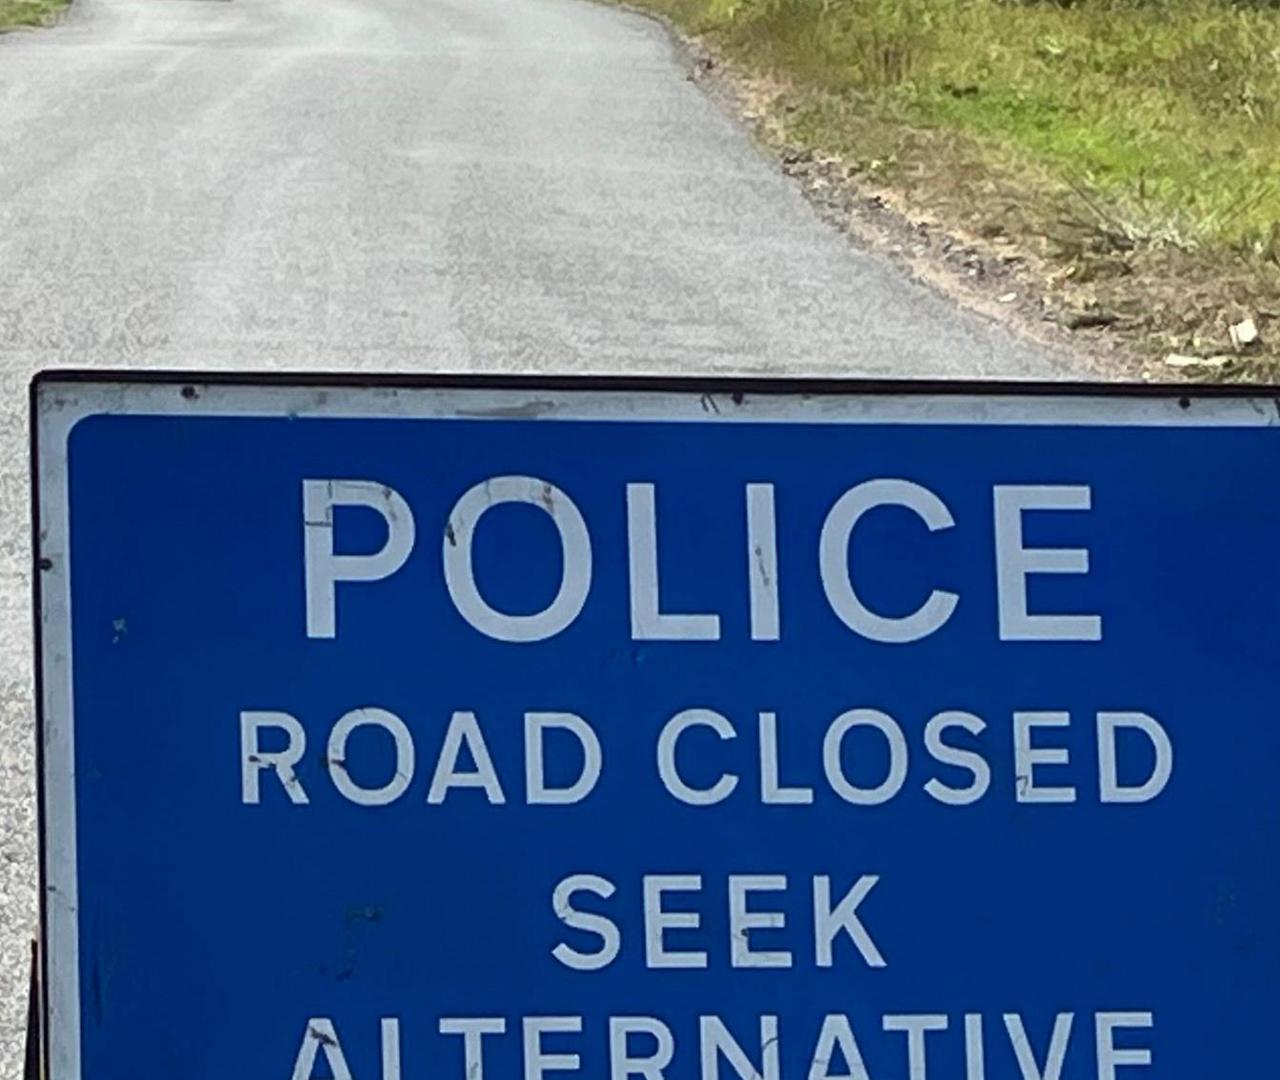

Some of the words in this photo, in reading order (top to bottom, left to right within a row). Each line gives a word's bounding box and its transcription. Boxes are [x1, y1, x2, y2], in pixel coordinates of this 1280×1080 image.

[304, 476, 1102, 643] POLICE
[240, 708, 602, 806] ROAD
[657, 708, 1173, 806] CLOSED
[551, 874, 888, 970] SEEK
